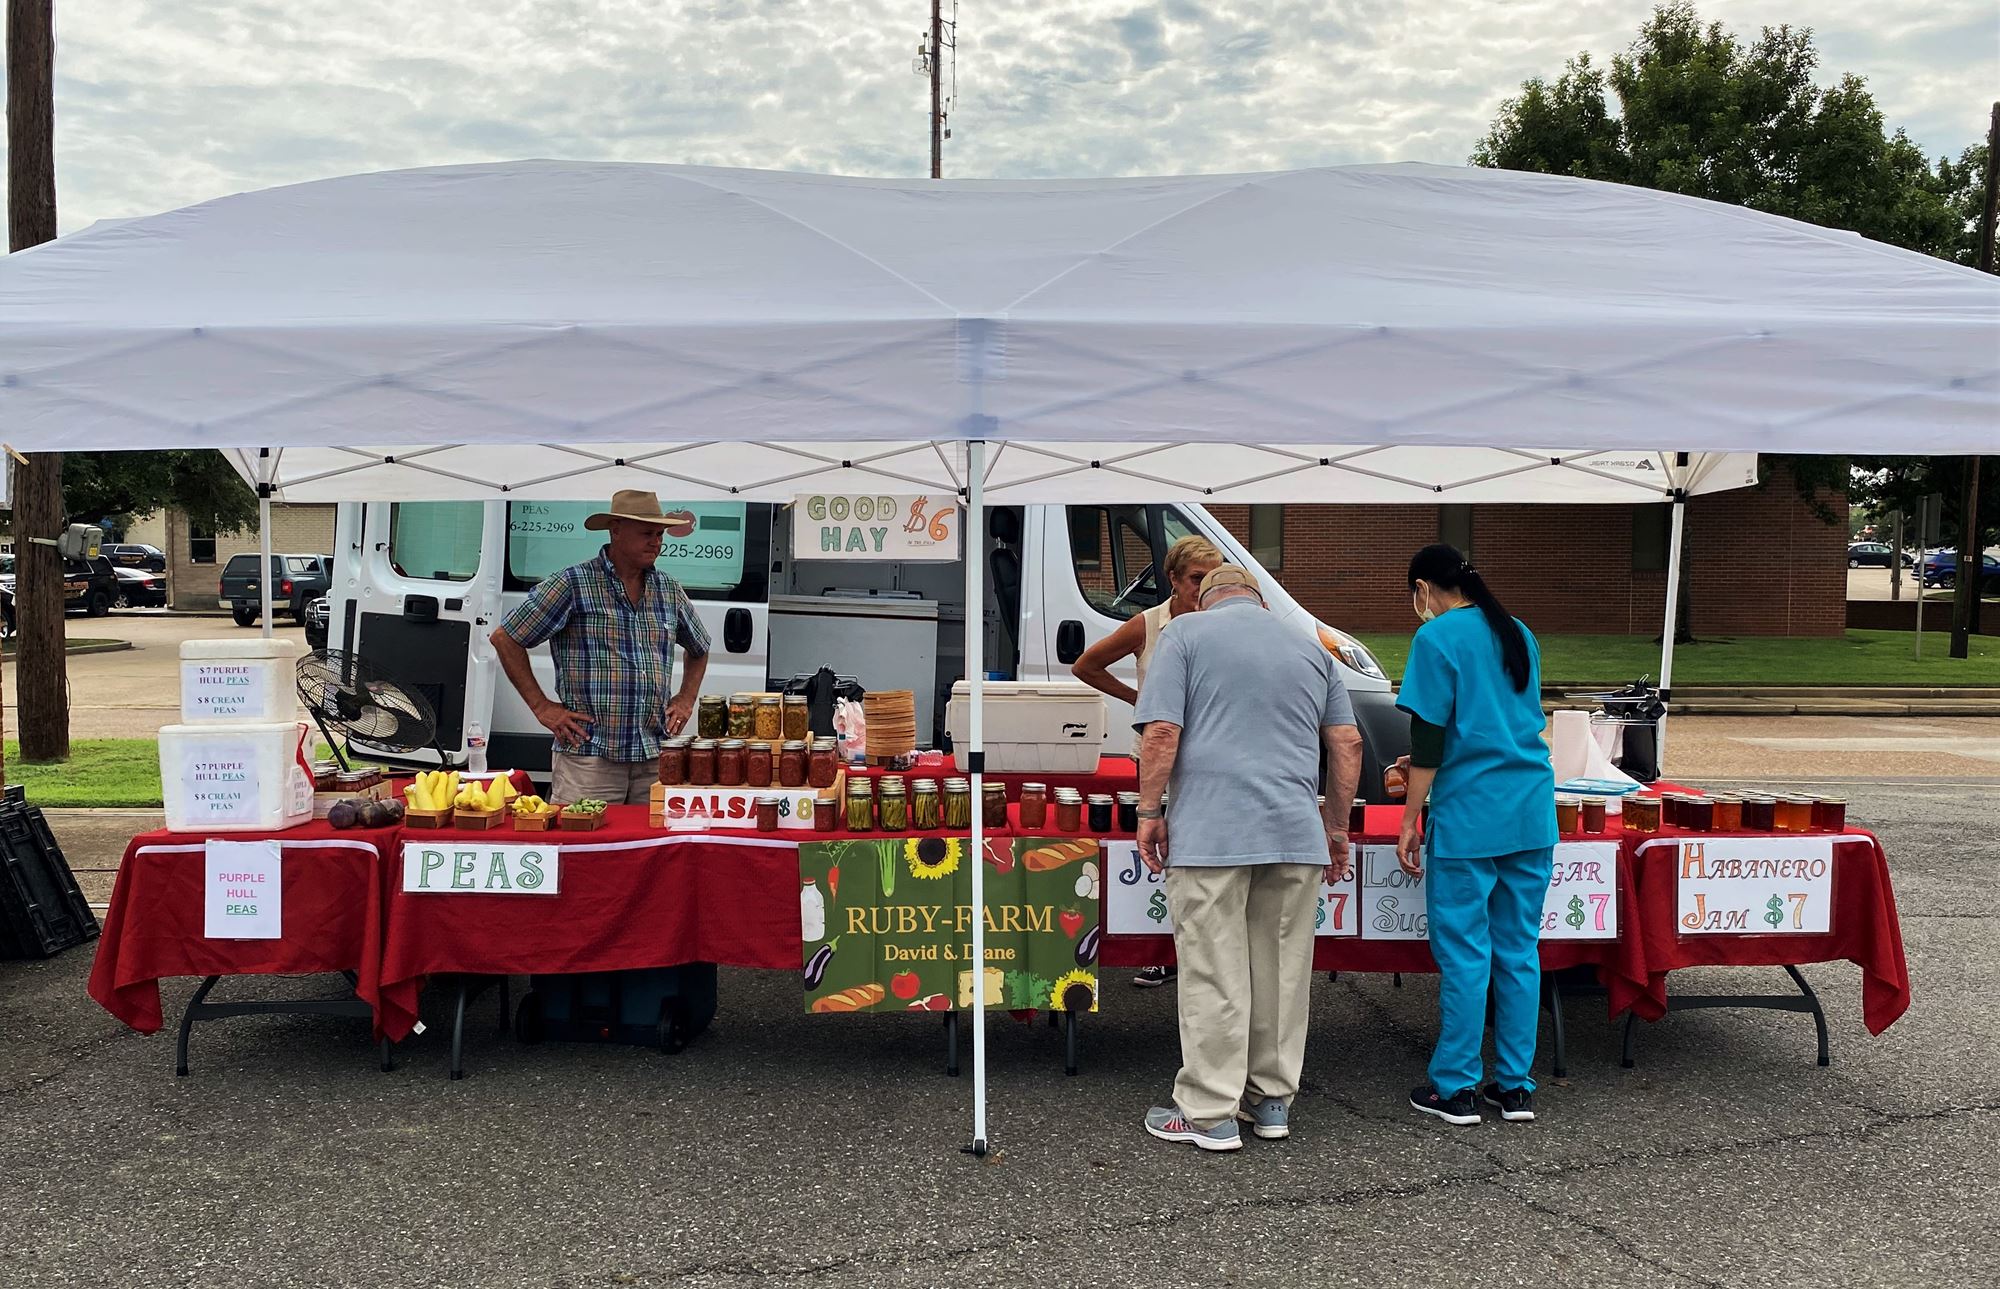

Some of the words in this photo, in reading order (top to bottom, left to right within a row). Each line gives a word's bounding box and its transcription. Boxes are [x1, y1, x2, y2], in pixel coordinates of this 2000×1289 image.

[522, 504, 550, 515] PEAS
[807, 495, 897, 521] GOOD
[903, 495, 955, 541] $6
[510, 520, 575, 533] 6-225-2969
[820, 526, 888, 552] HAY
[659, 543, 734, 560] 225-2969
[213, 666, 249, 674] PURPLE
[226, 676, 250, 685] PEAS
[211, 696, 245, 704] CREAM
[213, 706, 237, 714] PEAS
[208, 762, 245, 770] PURPLE
[195, 773, 221, 781] HULL
[222, 772, 246, 781] PEAS
[207, 792, 241, 801] CREAM
[210, 802, 234, 810] PEAS
[1681, 843, 1826, 881] HABANERO
[418, 850, 545, 889] PEAS
[1551, 861, 1605, 887] GAR
[219, 873, 265, 883] PURPLE
[226, 888, 257, 898] HULL
[226, 904, 258, 915] PEAS
[1565, 893, 1611, 931] $7
[1681, 893, 1750, 930] JAM
[1763, 893, 1808, 930] $7
[884, 944, 938, 961] David
[943, 943, 958, 961] &
[962, 943, 1016, 961] Dane
